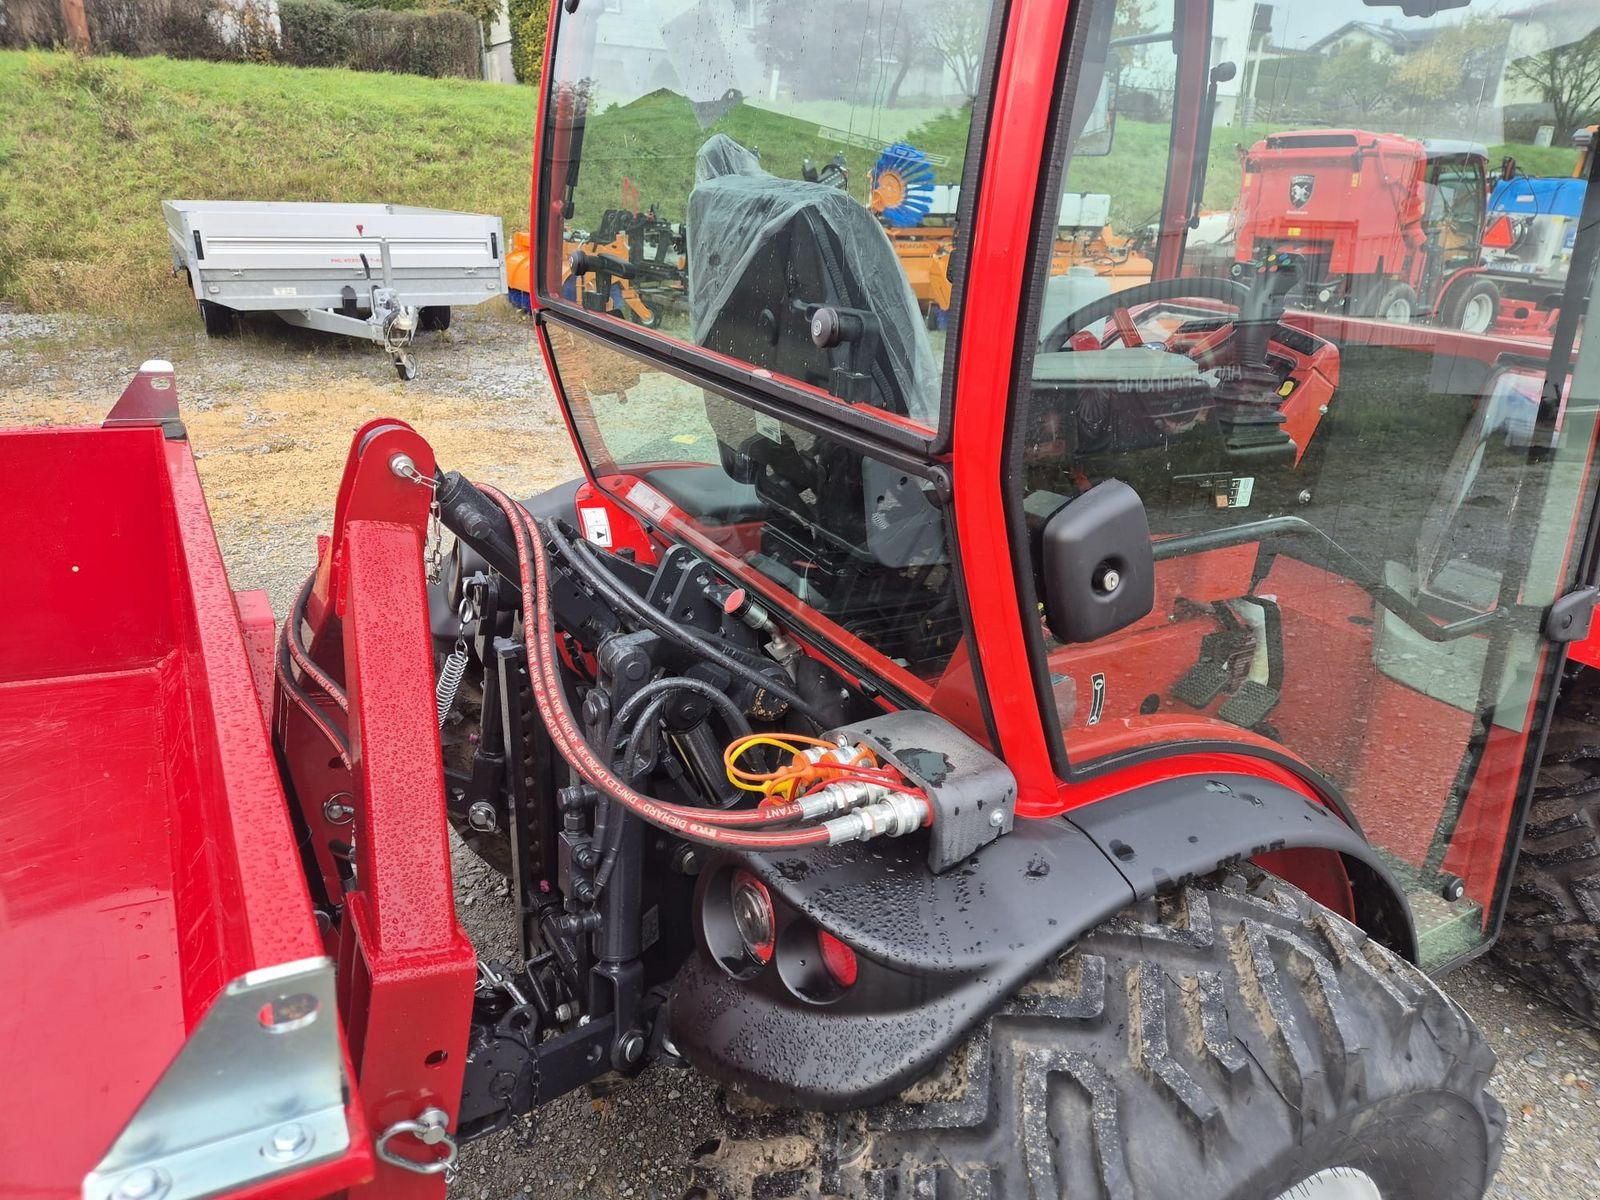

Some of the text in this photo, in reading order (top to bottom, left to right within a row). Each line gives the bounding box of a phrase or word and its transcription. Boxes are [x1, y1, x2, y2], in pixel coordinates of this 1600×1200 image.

[524, 610, 533, 625] BAR
[527, 637, 535, 647] WP
[540, 632, 548, 643] PSI
[528, 648, 537, 663] MAX
[543, 660, 553, 675] BAR
[548, 686, 558, 698] WP
[551, 698, 564, 715] MAX
[541, 705, 555, 727] DF26D
[557, 714, 572, 734] DN10
[550, 725, 571, 755] DINFLEX
[583, 755, 606, 779] DF26D
[603, 775, 638, 805] DINFLEX
[688, 822, 717, 837] RYCO
